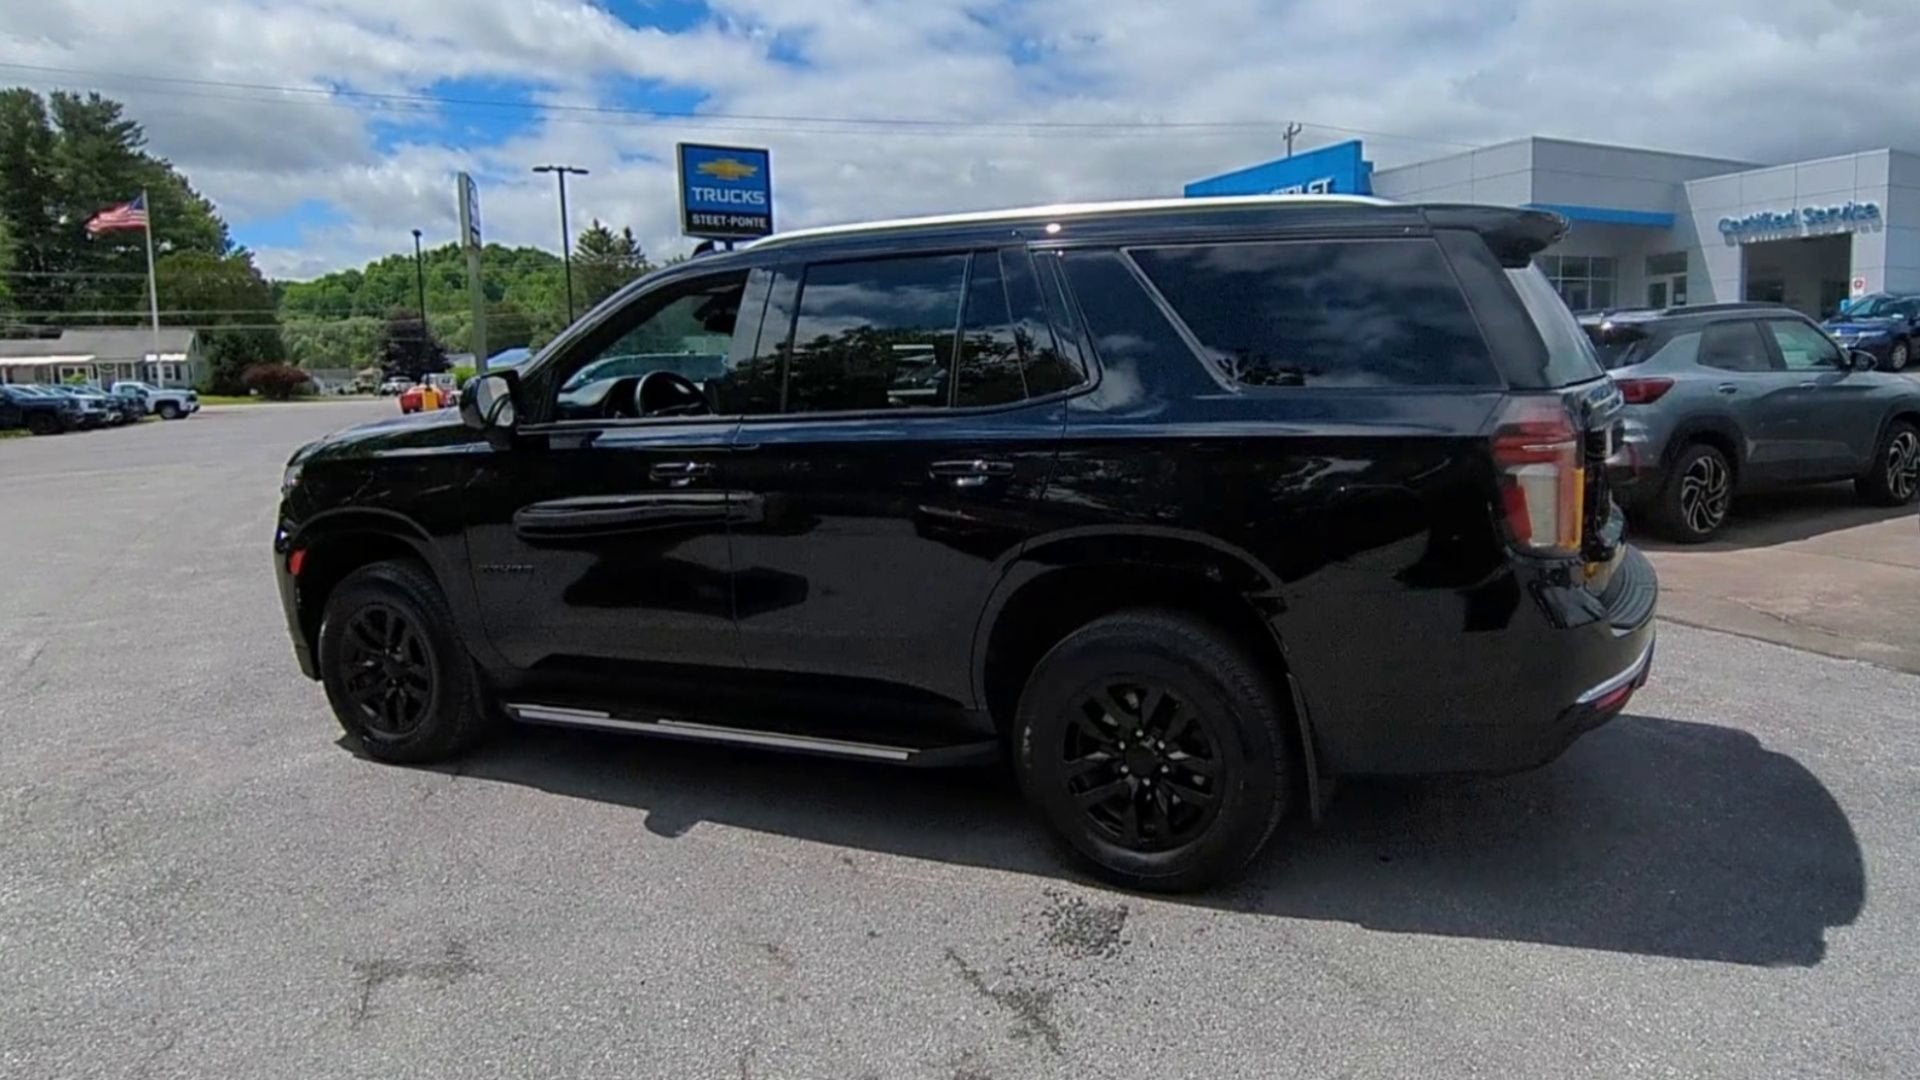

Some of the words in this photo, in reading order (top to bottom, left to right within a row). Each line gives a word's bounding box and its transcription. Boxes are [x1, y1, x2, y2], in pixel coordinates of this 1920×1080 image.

[691, 186, 766, 205] TRUCKS
[692, 213, 768, 229] STEET-PONTE
[1719, 208, 1796, 233] Certified
[1803, 201, 1879, 227] Service
